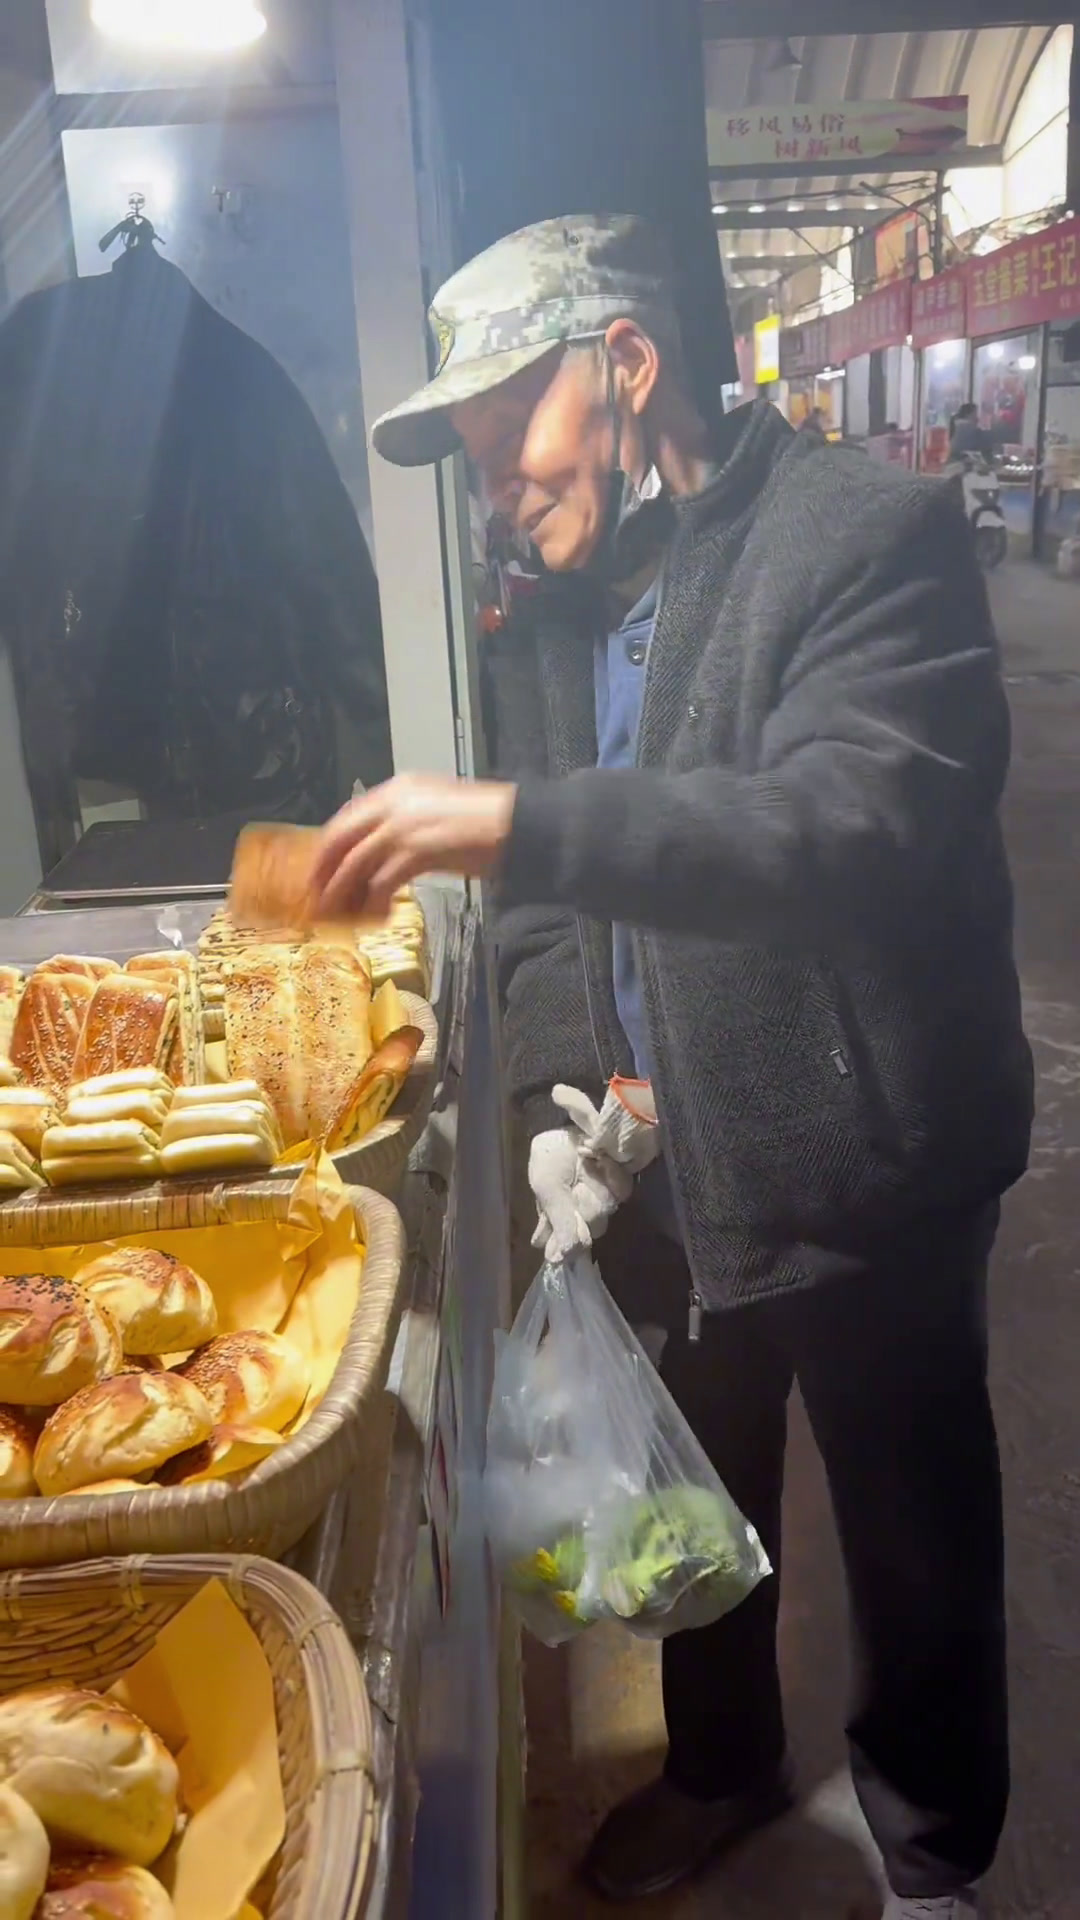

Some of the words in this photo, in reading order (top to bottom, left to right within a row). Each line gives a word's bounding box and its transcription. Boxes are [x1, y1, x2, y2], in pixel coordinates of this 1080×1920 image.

[727, 112, 846, 136] 移风易俗
[775, 135, 863, 159] 树新风
